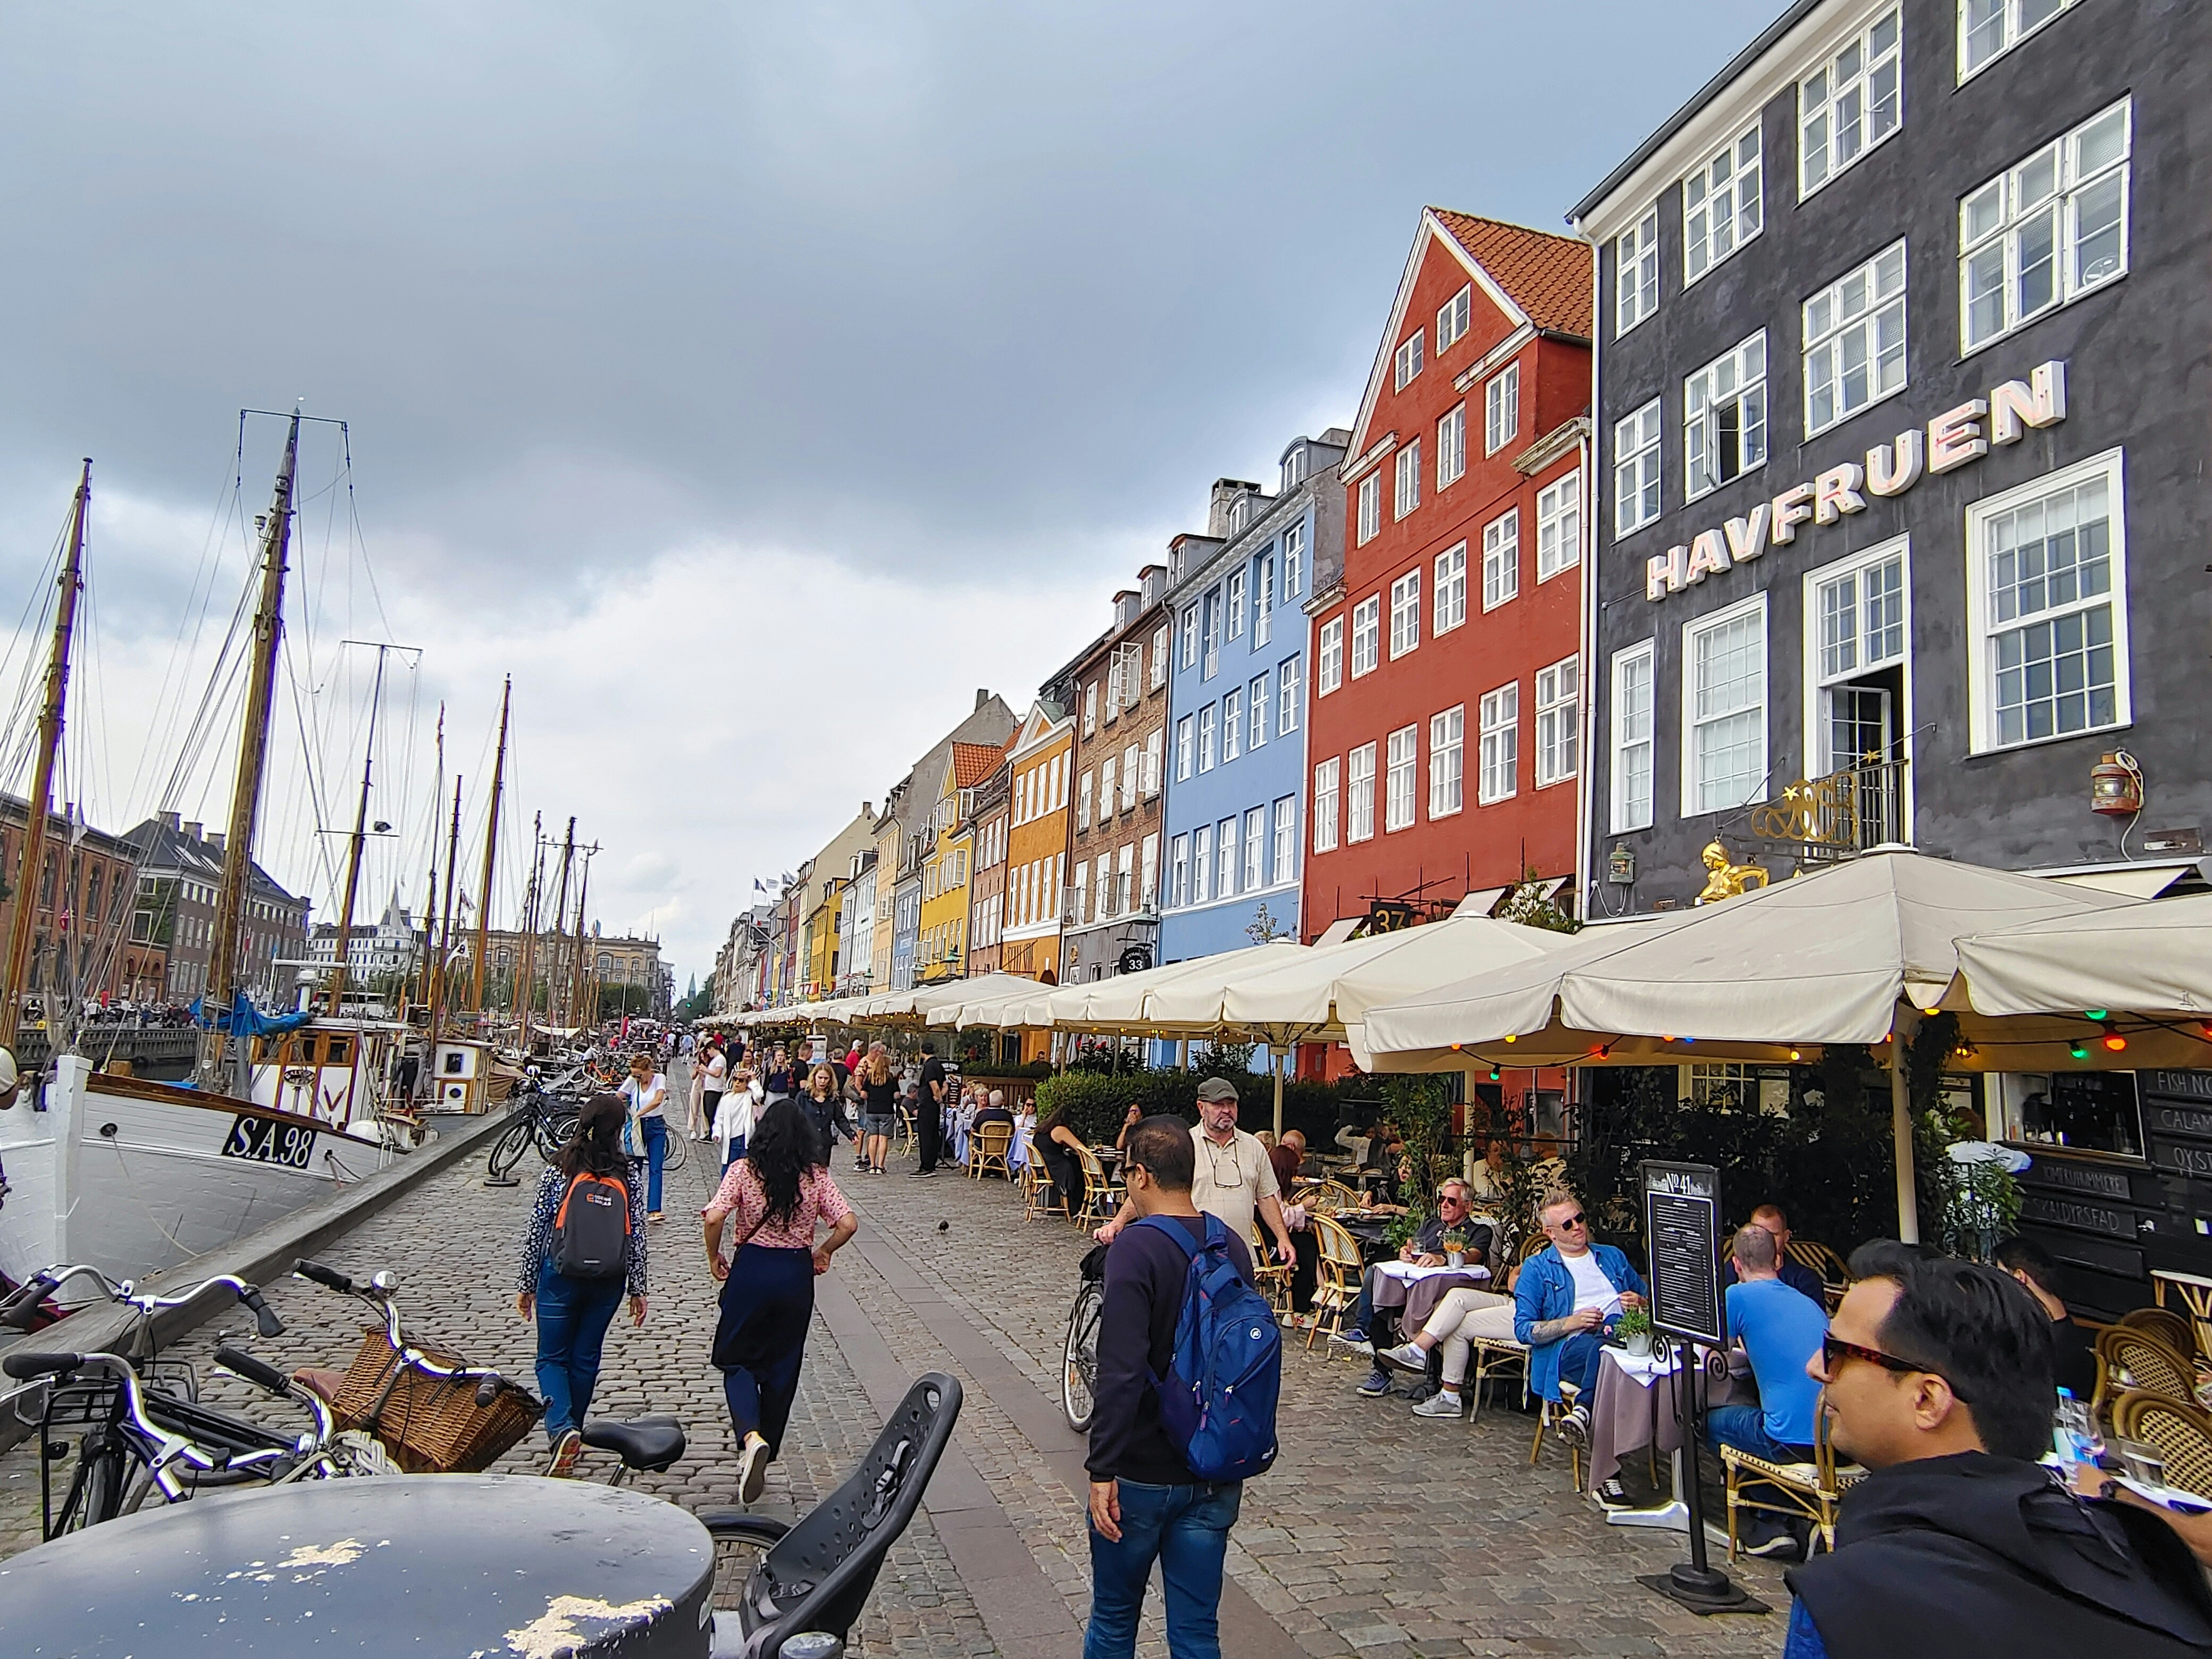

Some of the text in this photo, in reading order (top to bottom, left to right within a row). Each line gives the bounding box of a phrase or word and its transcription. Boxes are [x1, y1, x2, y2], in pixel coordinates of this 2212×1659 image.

[1646, 361, 2066, 601] HAVFRUEN
[1375, 910, 1406, 934] 37
[1128, 959, 1143, 970] 33
[2158, 1071, 2187, 1092] FISH
[1680, 1175, 1692, 1195] 41
